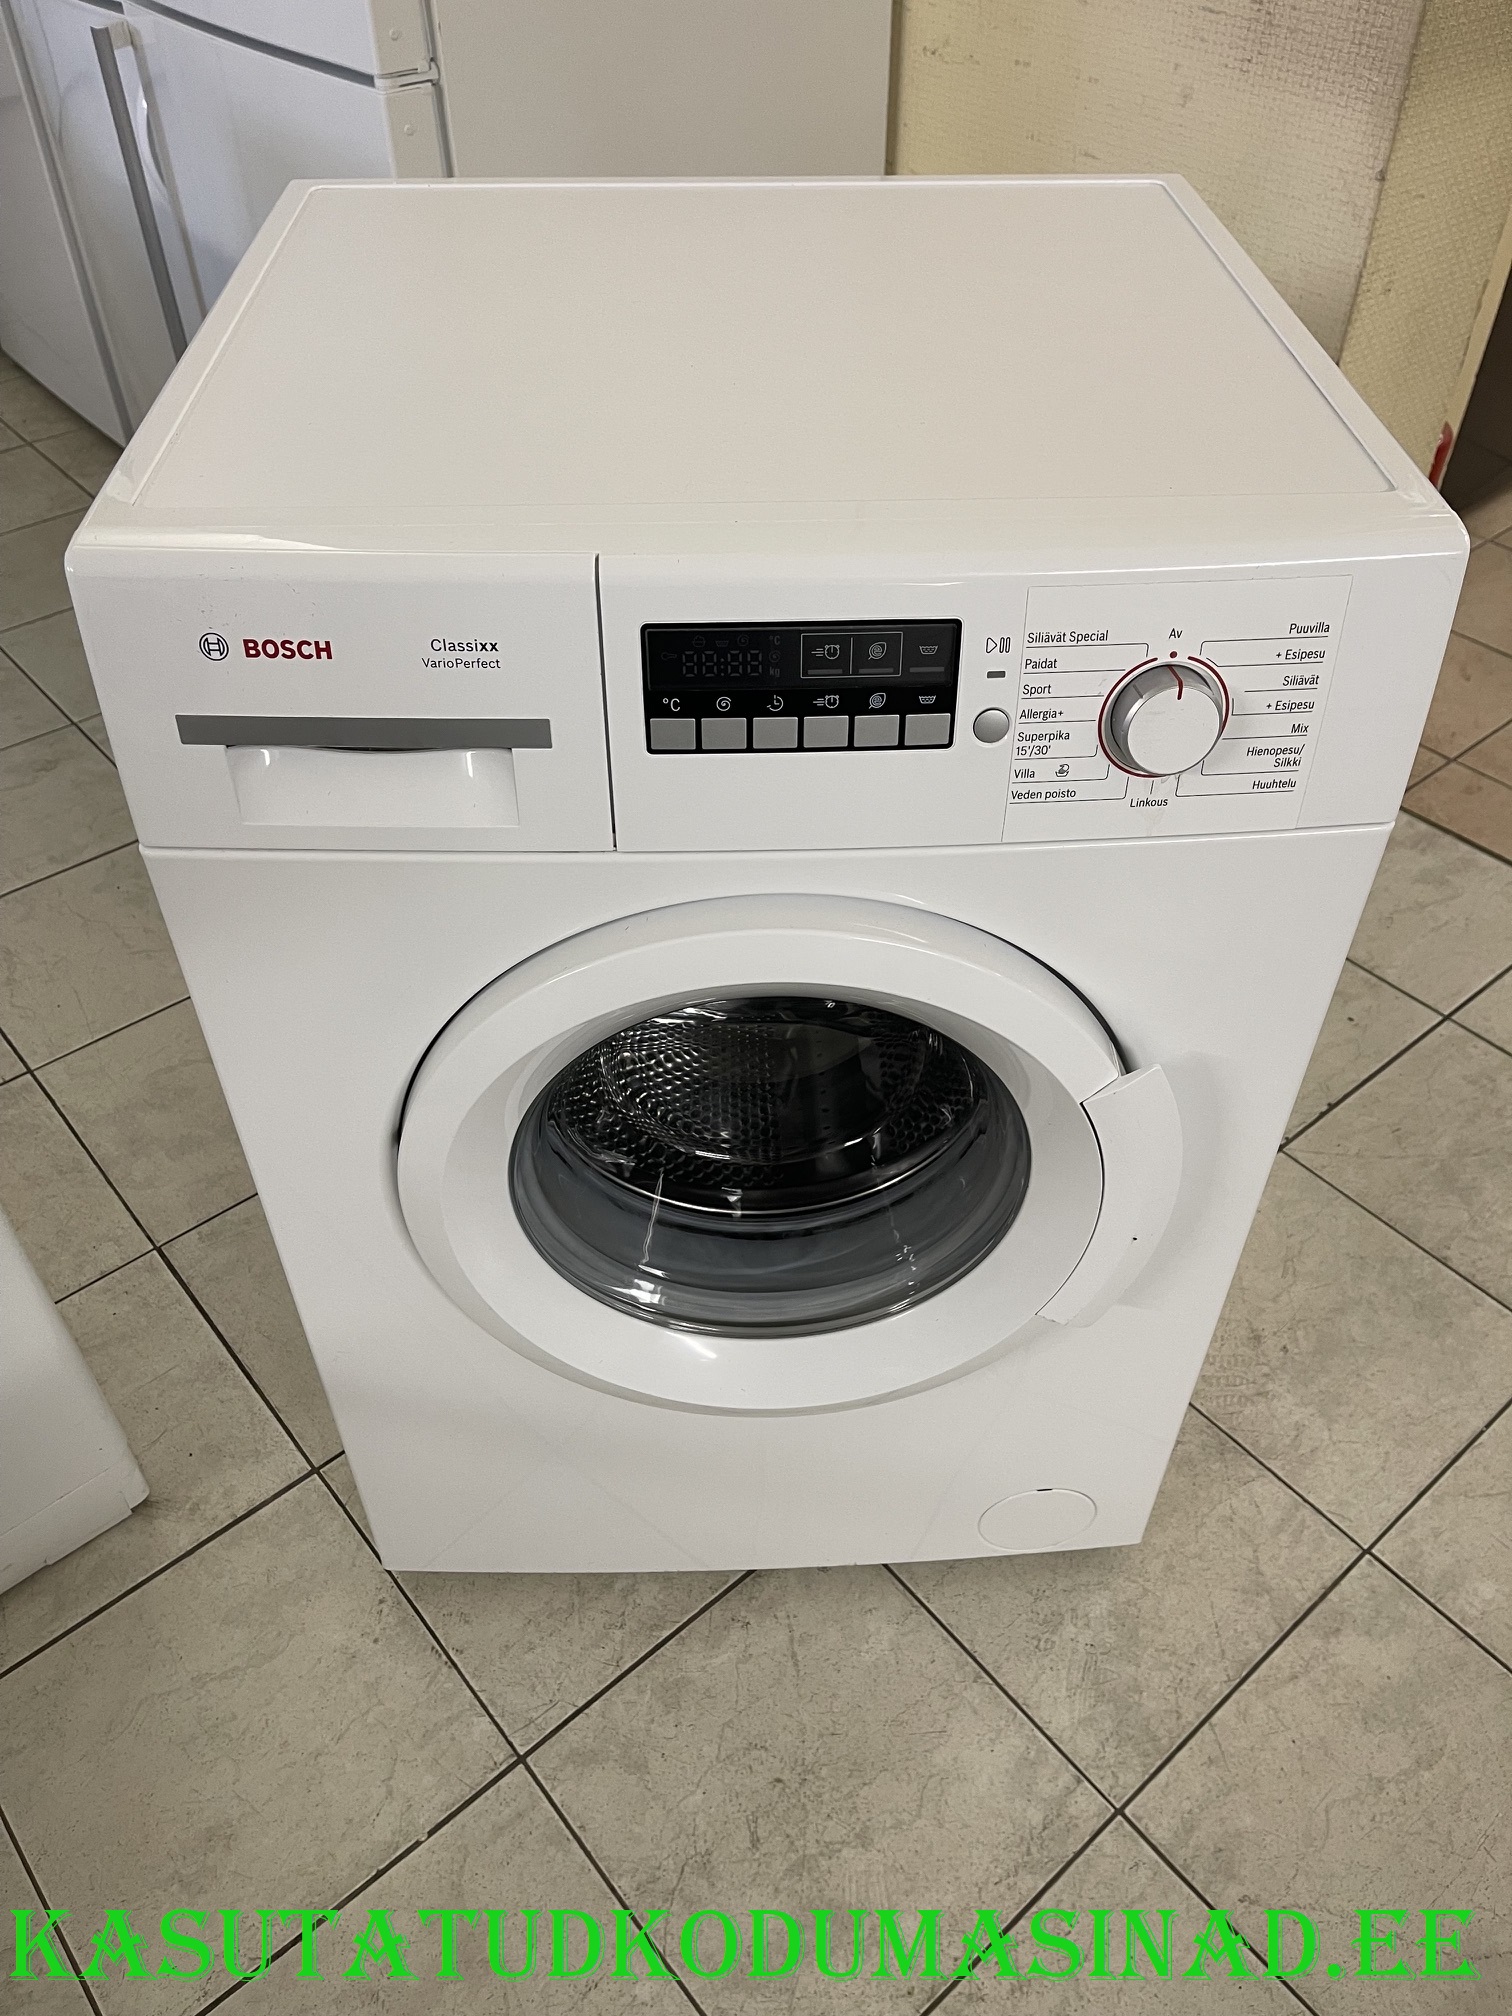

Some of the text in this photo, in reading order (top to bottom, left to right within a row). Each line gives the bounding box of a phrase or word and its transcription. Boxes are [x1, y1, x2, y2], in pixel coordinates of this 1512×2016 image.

[1168, 627, 1183, 640] Av
[1289, 621, 1330, 635] Puuvilla
[1027, 629, 1108, 644] Siliävät Special
[242, 638, 333, 660] BOSCH
[430, 638, 499, 652] Classixx
[1275, 648, 1326, 662] + Esipesu
[421, 657, 501, 669] VarioPerfect
[1024, 657, 1057, 670] Paidat
[1282, 673, 1320, 687] Siliävät
[1022, 683, 1052, 697] Sport
[662, 697, 681, 712] °C
[1266, 699, 1315, 713] + Esipesu
[1019, 707, 1064, 721] Allergia+
[1290, 723, 1309, 734] Mix
[1017, 729, 1070, 744] Superpika
[1015, 743, 1052, 756] 15'/30'
[1246, 743, 1305, 758] Hienopesu/
[1273, 756, 1302, 768] Silkki
[1013, 768, 1035, 779] Villa
[1252, 778, 1297, 790] Huuhtelu
[1011, 788, 1077, 802] Veden poisto
[1129, 796, 1168, 808] Linkous
